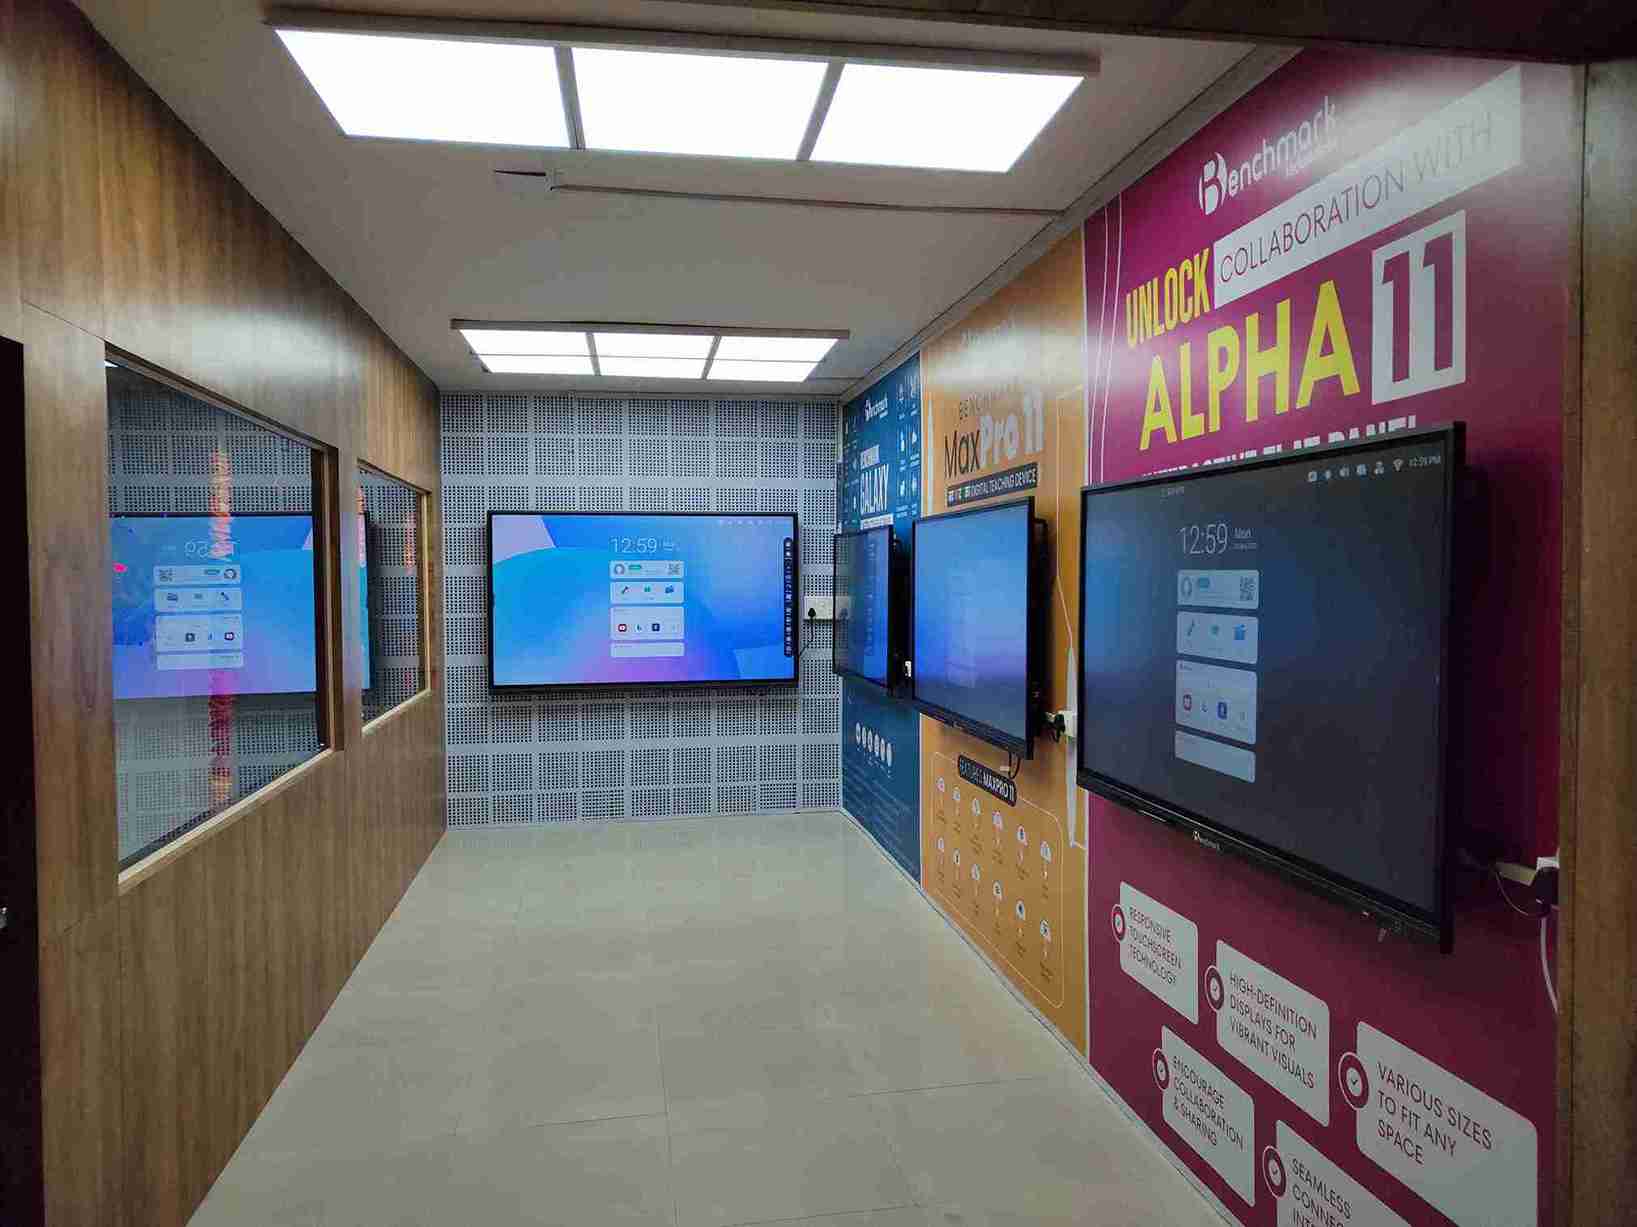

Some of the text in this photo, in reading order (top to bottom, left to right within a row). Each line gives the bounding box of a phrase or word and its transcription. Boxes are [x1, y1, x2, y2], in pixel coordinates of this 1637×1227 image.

[1199, 96, 1337, 216] Benchmark
[1126, 111, 1494, 348] UNLOCK COLLABORATION WITH
[1138, 220, 1460, 451] ALPHA 11
[861, 463, 890, 516] GALAXY
[609, 536, 658, 554] 12:59
[1177, 522, 1229, 555] 12:59
[1128, 905, 1172, 944] RESPONSIVE
[1128, 924, 1182, 970] TOUCHSCREEN
[1128, 943, 1177, 985] TECHNOLOGY
[1229, 971, 1318, 1040] HIGH-DEFINITION
[1229, 993, 1297, 1053] DISPLAYS FOR
[1173, 1055, 1225, 1111] ENCOURAGE
[1229, 1017, 1315, 1090] VIBRANT VISUALS
[1173, 1076, 1244, 1152] COLLABORATION
[1180, 1102, 1218, 1147] SHARING
[1376, 1060, 1493, 1151] VARIOUS SIZES
[1377, 1089, 1457, 1158] TO FIT ANY
[1377, 1118, 1424, 1166] SPACE
[1291, 1157, 1353, 1220] SEAMLESS
